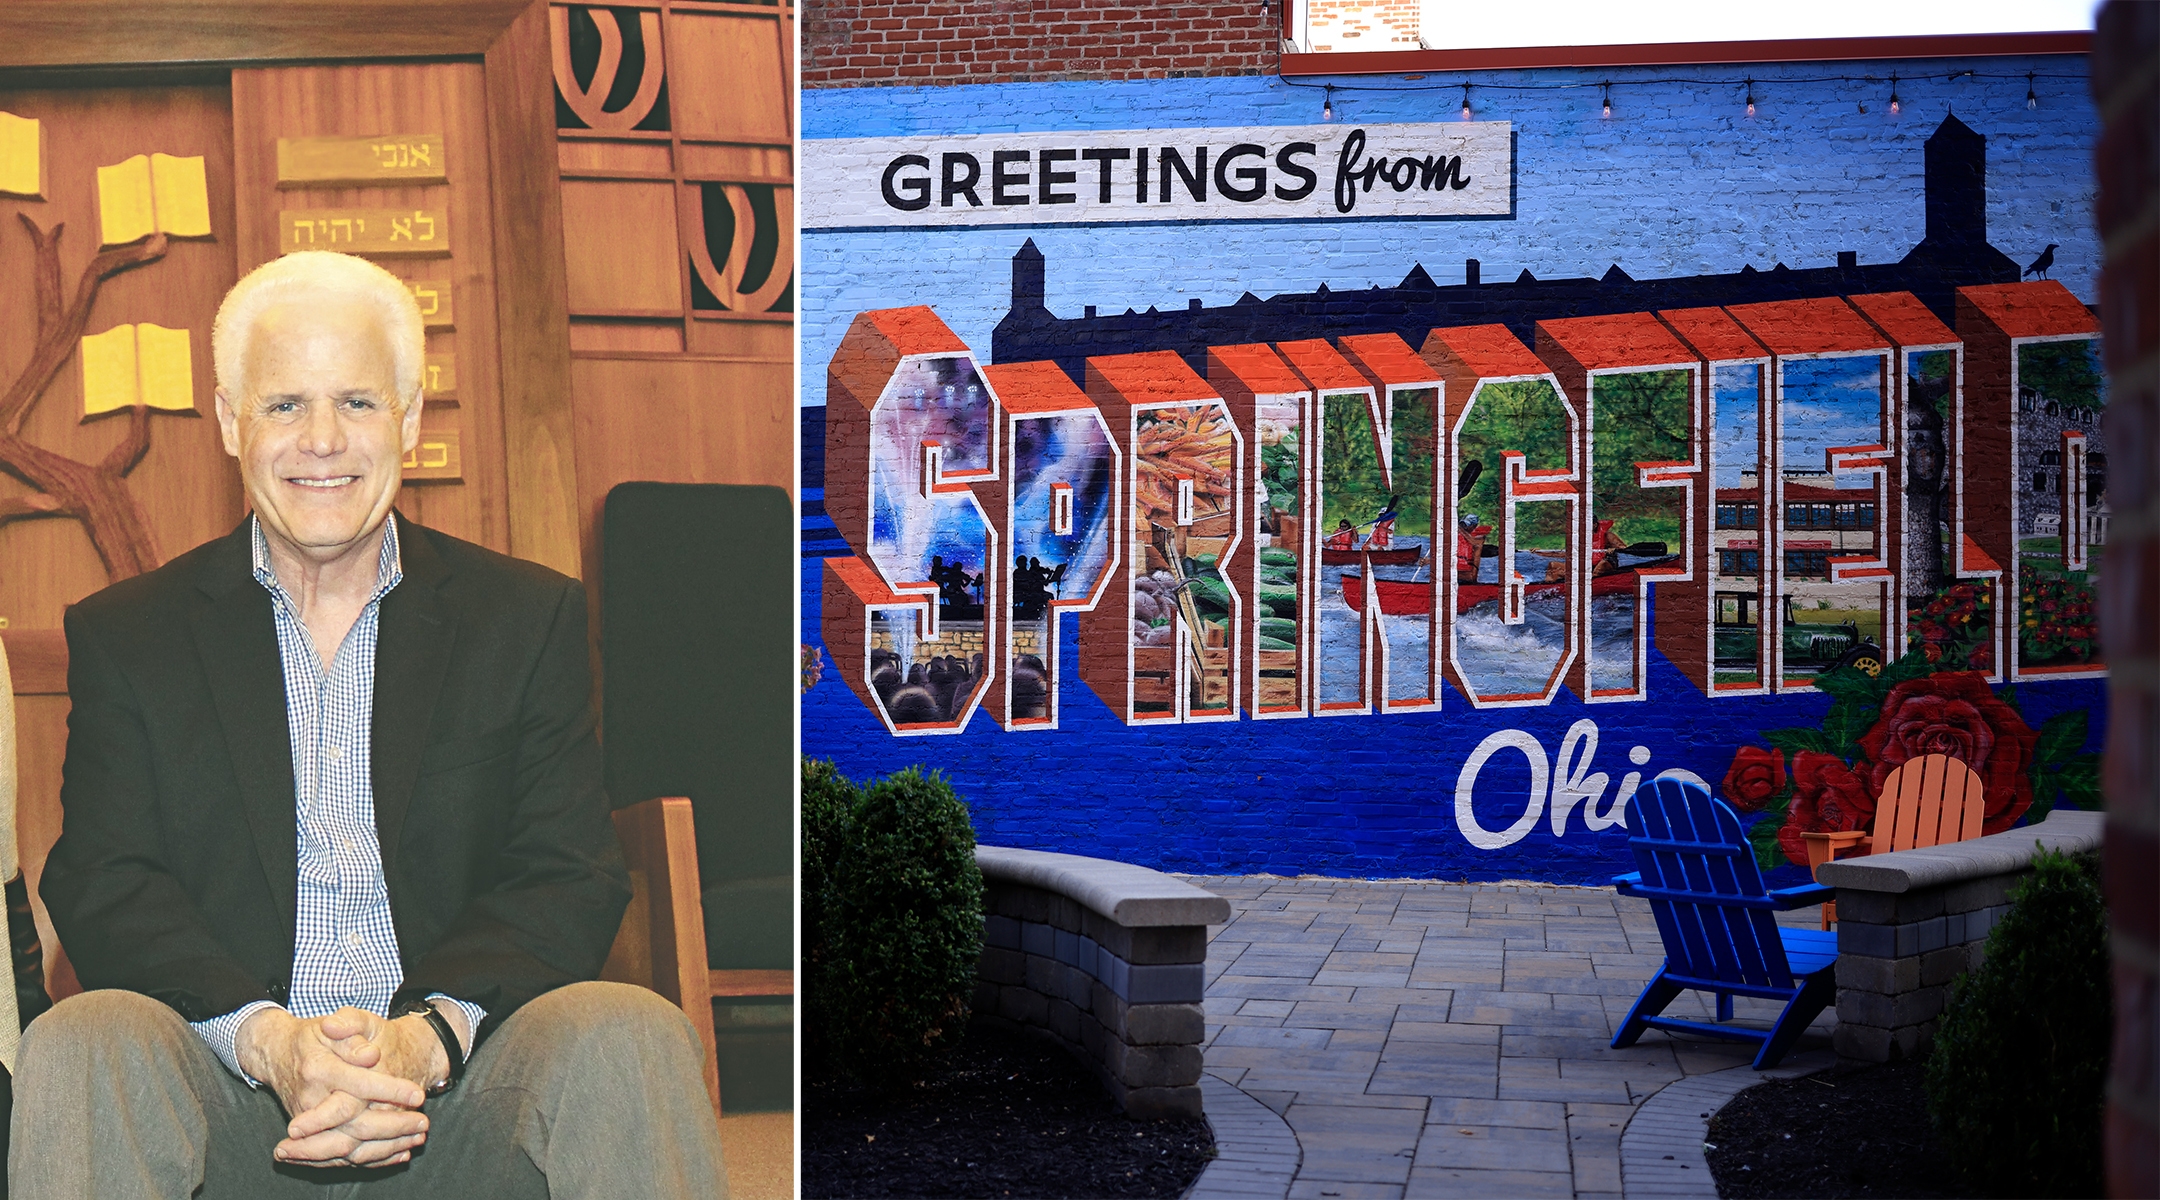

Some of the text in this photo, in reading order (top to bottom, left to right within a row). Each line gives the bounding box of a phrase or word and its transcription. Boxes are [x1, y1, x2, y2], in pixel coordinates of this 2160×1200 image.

[371, 143, 432, 168] אנכי
[880, 128, 1472, 214] GREETINGS from
[293, 210, 435, 244] לא יהיה
[415, 285, 439, 315] ל
[1454, 718, 1712, 850] Ohi
